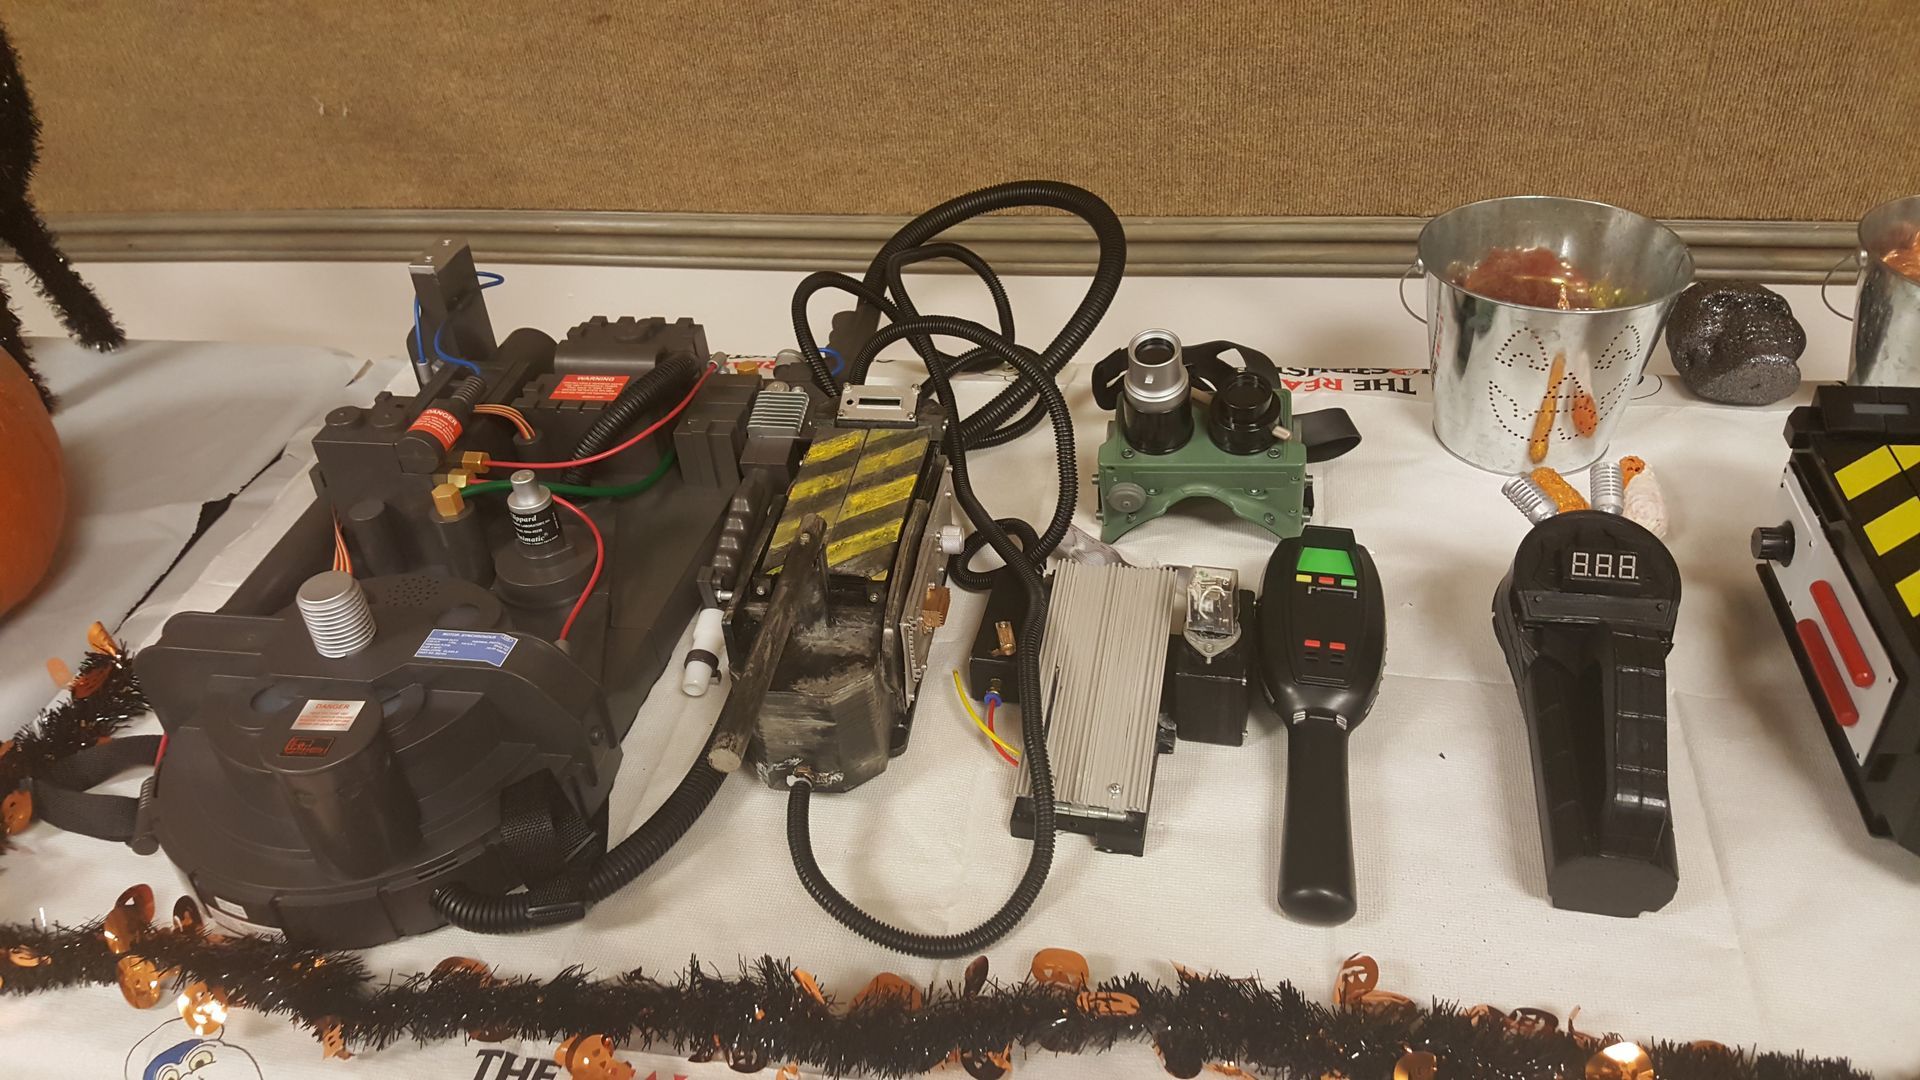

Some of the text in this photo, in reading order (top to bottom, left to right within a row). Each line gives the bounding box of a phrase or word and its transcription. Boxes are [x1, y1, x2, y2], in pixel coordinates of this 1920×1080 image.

[1353, 377, 1417, 395] THE
[426, 409, 458, 426] DANGER
[475, 1049, 562, 1080] THE
